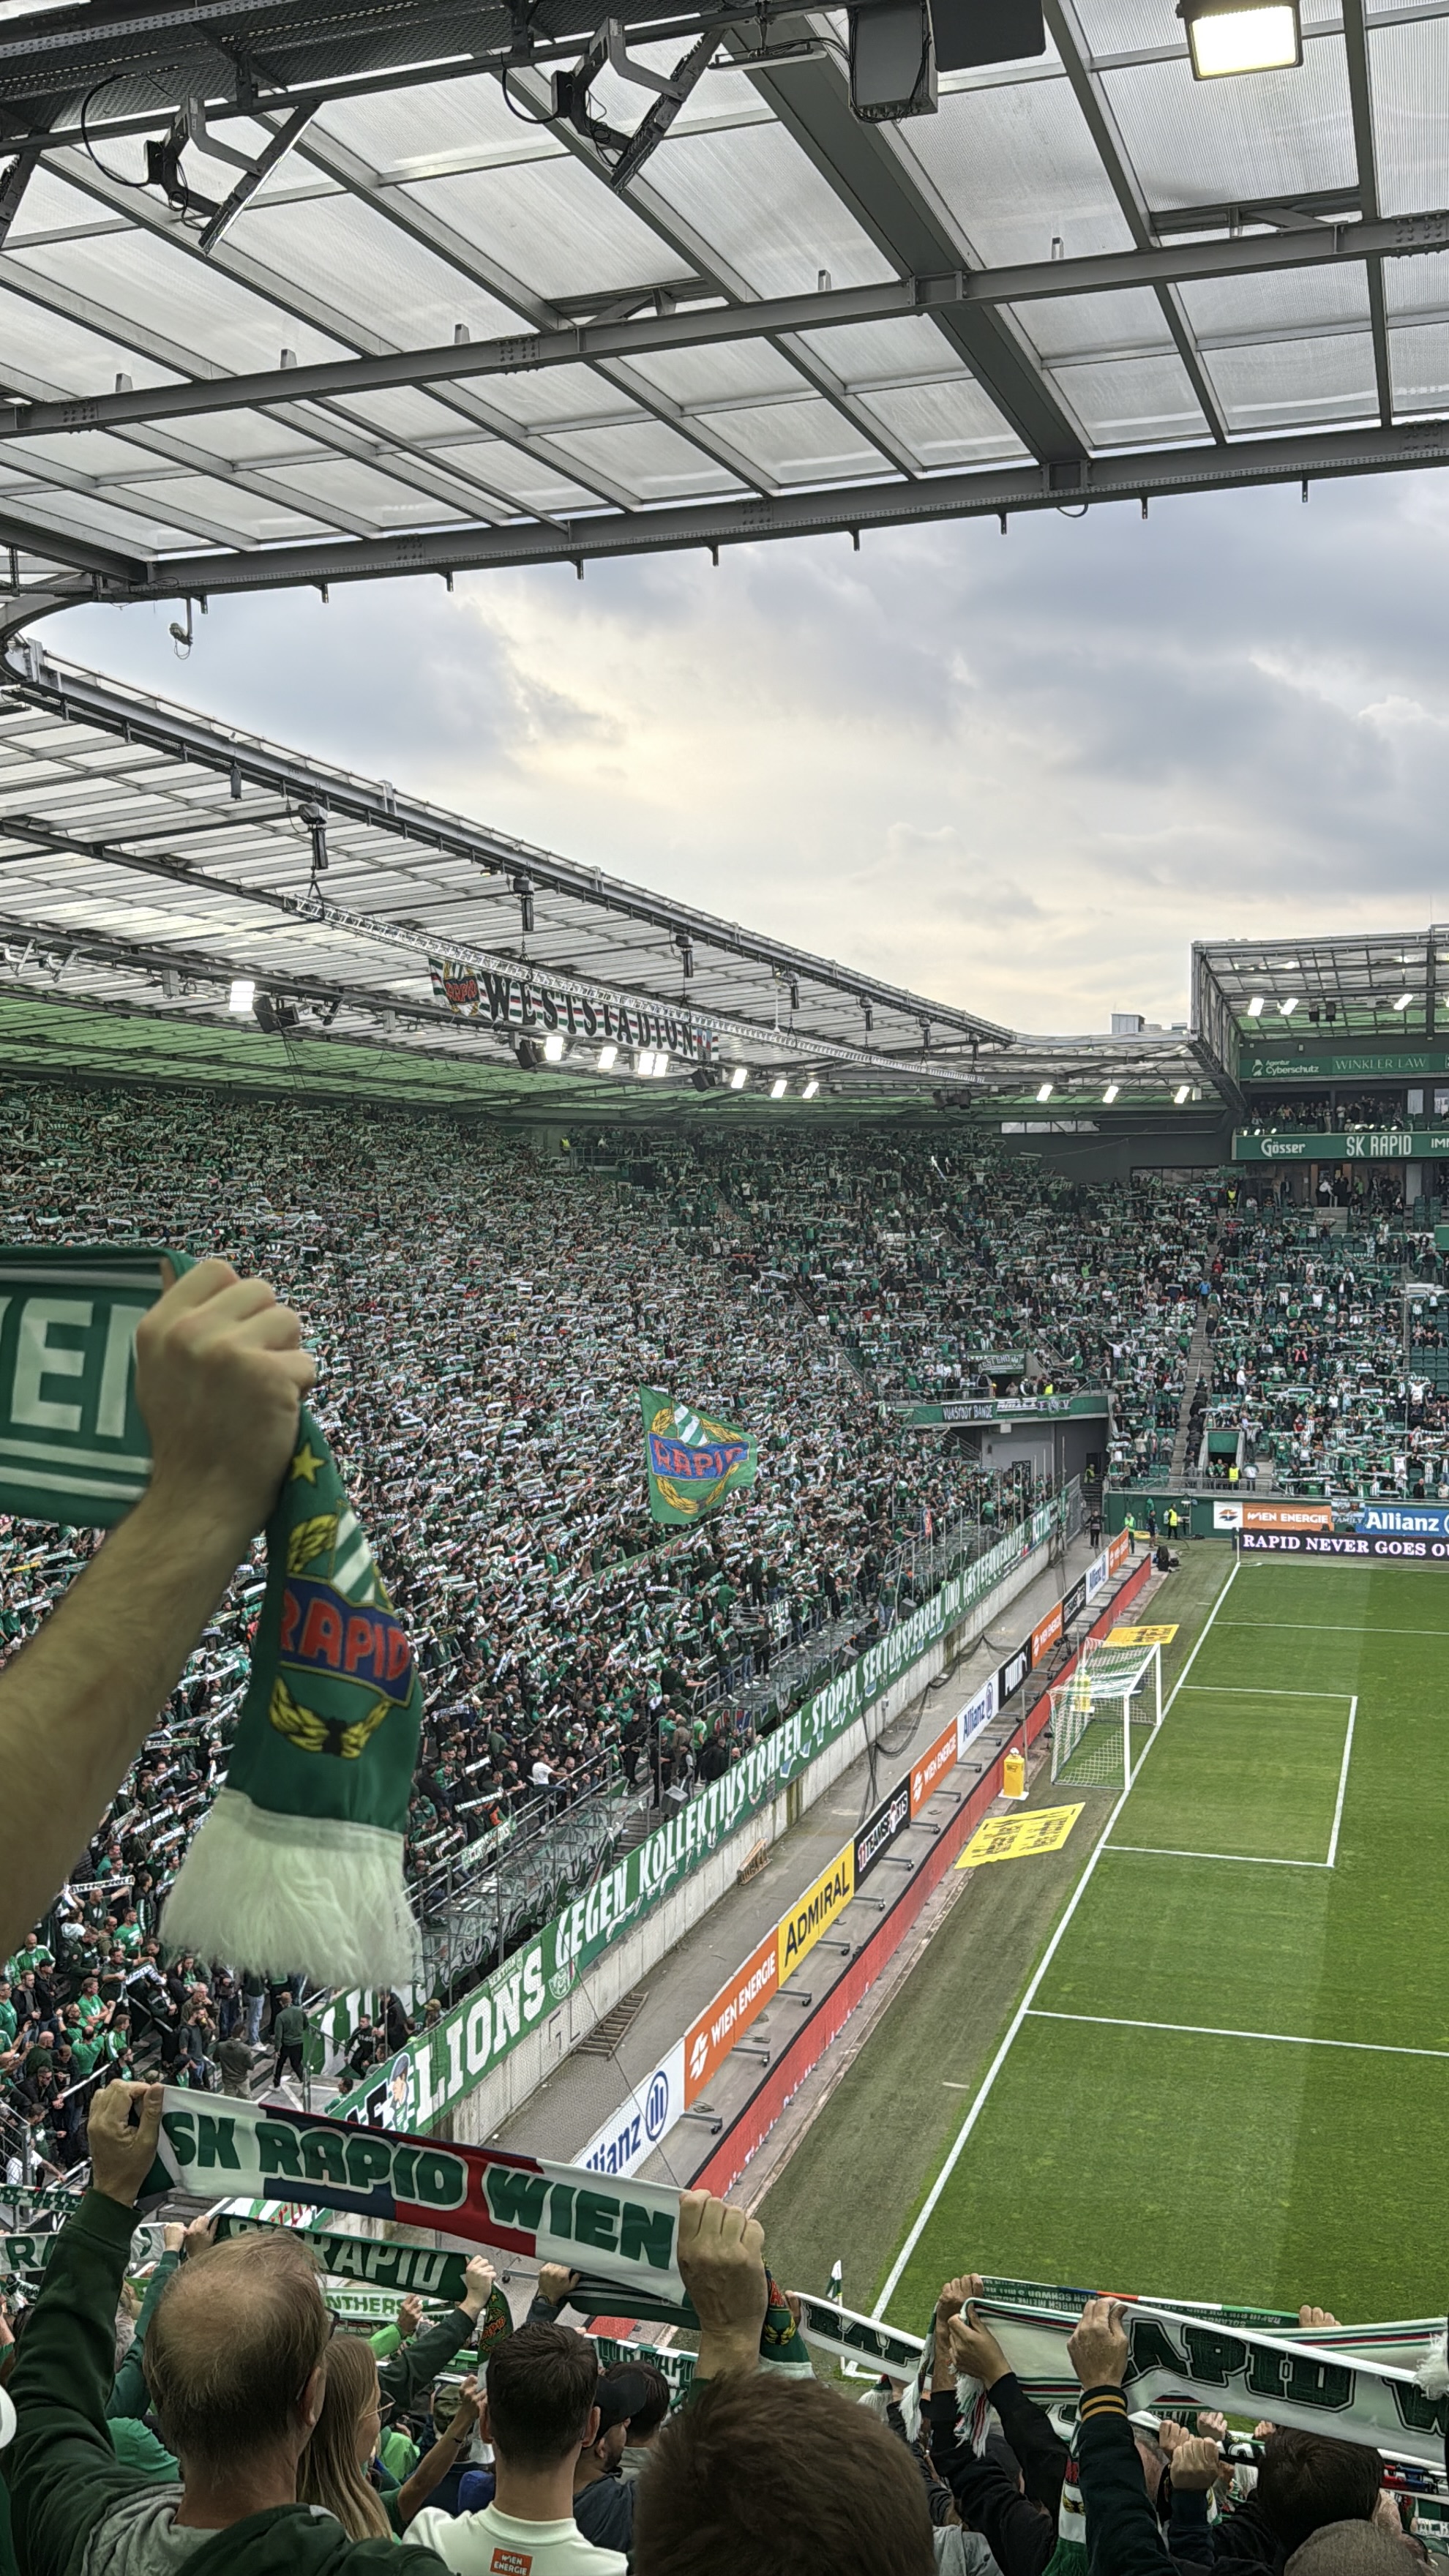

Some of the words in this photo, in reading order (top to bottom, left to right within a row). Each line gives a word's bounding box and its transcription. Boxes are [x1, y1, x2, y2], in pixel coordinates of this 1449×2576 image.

[480, 970, 694, 1058] WESTSTADION
[1265, 1065, 1319, 1075] Cyberschutz
[1336, 1058, 1393, 1070] WINKLER
[1398, 1057, 1426, 1068] LAW
[1261, 1139, 1306, 1158] Gösser
[1346, 1137, 1365, 1156] SK
[1370, 1134, 1412, 1156] RAPID
[1247, 1512, 1277, 1521] WIEN
[1280, 1513, 1328, 1524] ENERGIE
[1366, 1511, 1439, 1532] Allianz
[1243, 1534, 1301, 1550] RAPID
[1305, 1537, 1369, 1553] NEVER
[1374, 1541, 1426, 1556] GOES
[280, 1588, 410, 1682] RAPID
[962, 1700, 985, 1742] Allianz
[555, 1860, 628, 1970] GEGEN
[639, 1710, 803, 1894] KOLLEKTIVSTRAFEN
[812, 1662, 858, 1737] STOPPT
[862, 1592, 943, 1690] SEKTORSPERREN
[945, 1578, 961, 1617] UND
[784, 1861, 851, 1967] ADMIRAL
[711, 1994, 739, 2042] WIEN
[738, 1950, 776, 2012] ENERGIE
[413, 1945, 546, 2127] LIONS
[162, 2111, 242, 2169] SK
[256, 2120, 468, 2212] RAPID
[482, 2165, 677, 2272] WIEN
[302, 2232, 449, 2291] RAPID
[323, 2296, 405, 2315] NTHERS
[1121, 2318, 1356, 2413] APID
[493, 2560, 528, 2576] ENERGIE
[501, 2553, 523, 2566] WIEN
